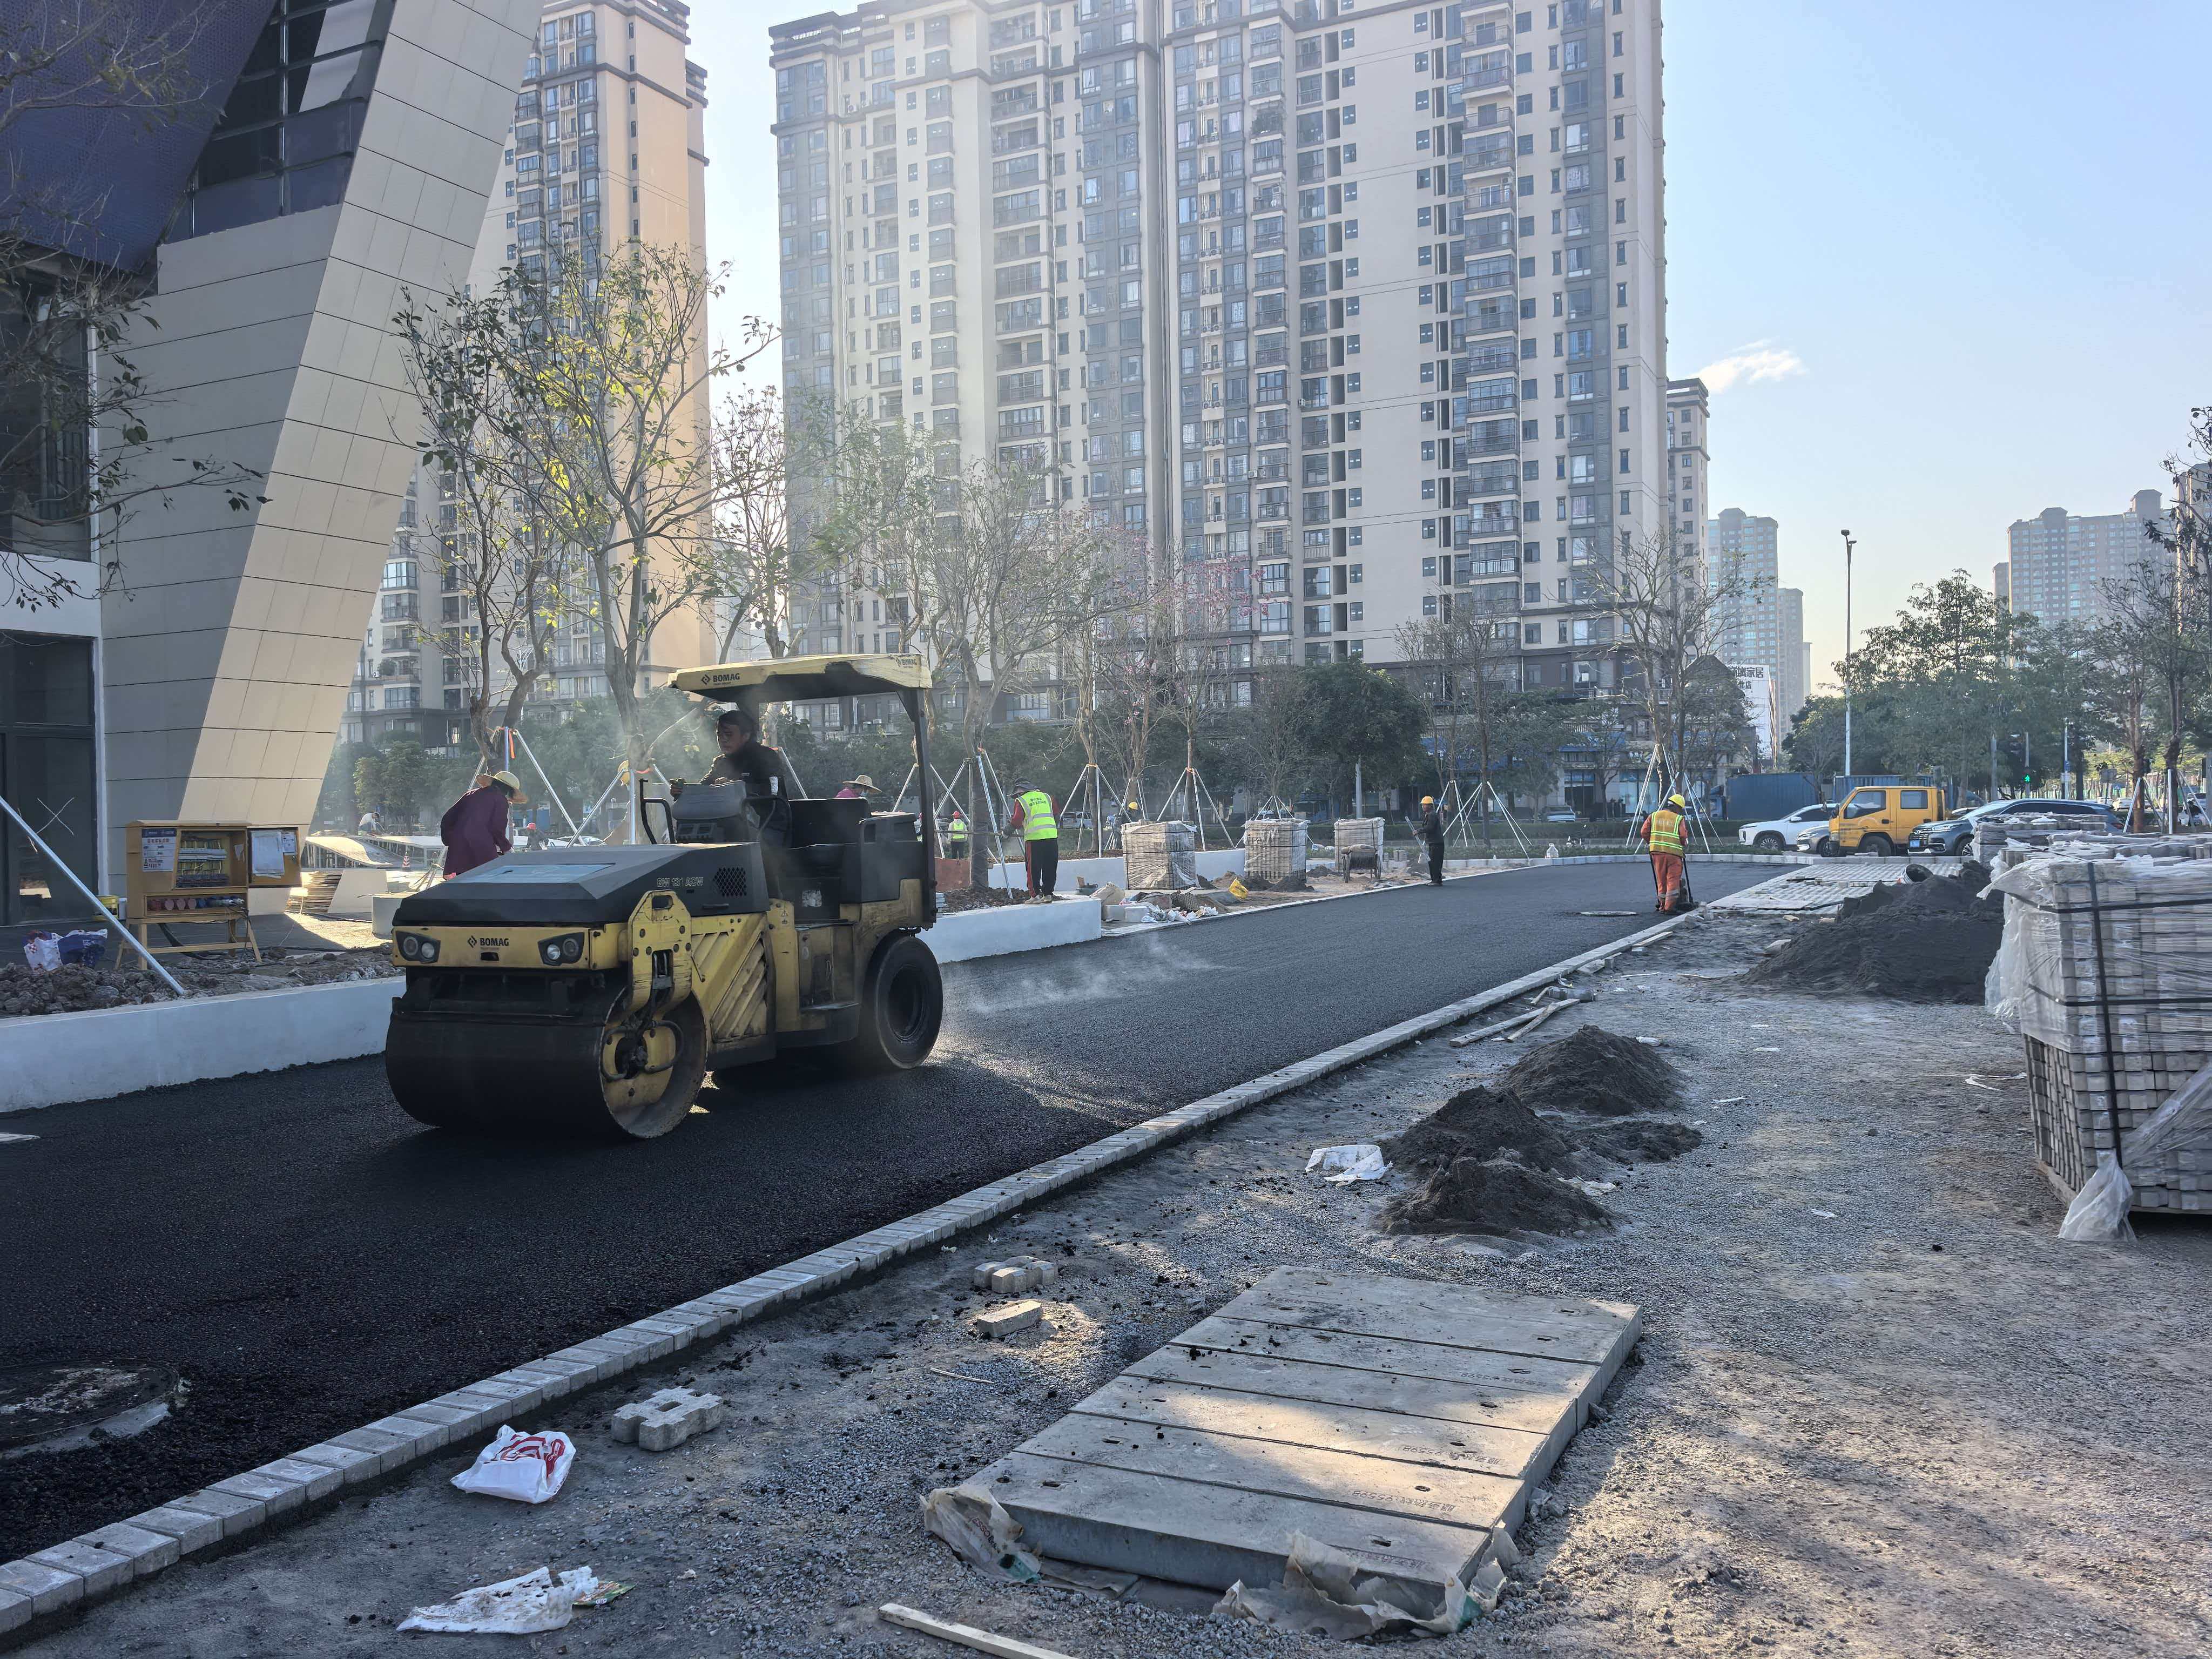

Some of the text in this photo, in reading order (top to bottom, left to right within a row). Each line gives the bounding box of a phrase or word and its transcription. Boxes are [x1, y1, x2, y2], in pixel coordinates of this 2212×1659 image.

[713, 673, 740, 682] BOMAG
[656, 876, 704, 888] BW 131 ACW
[479, 938, 509, 946] BOMAG
